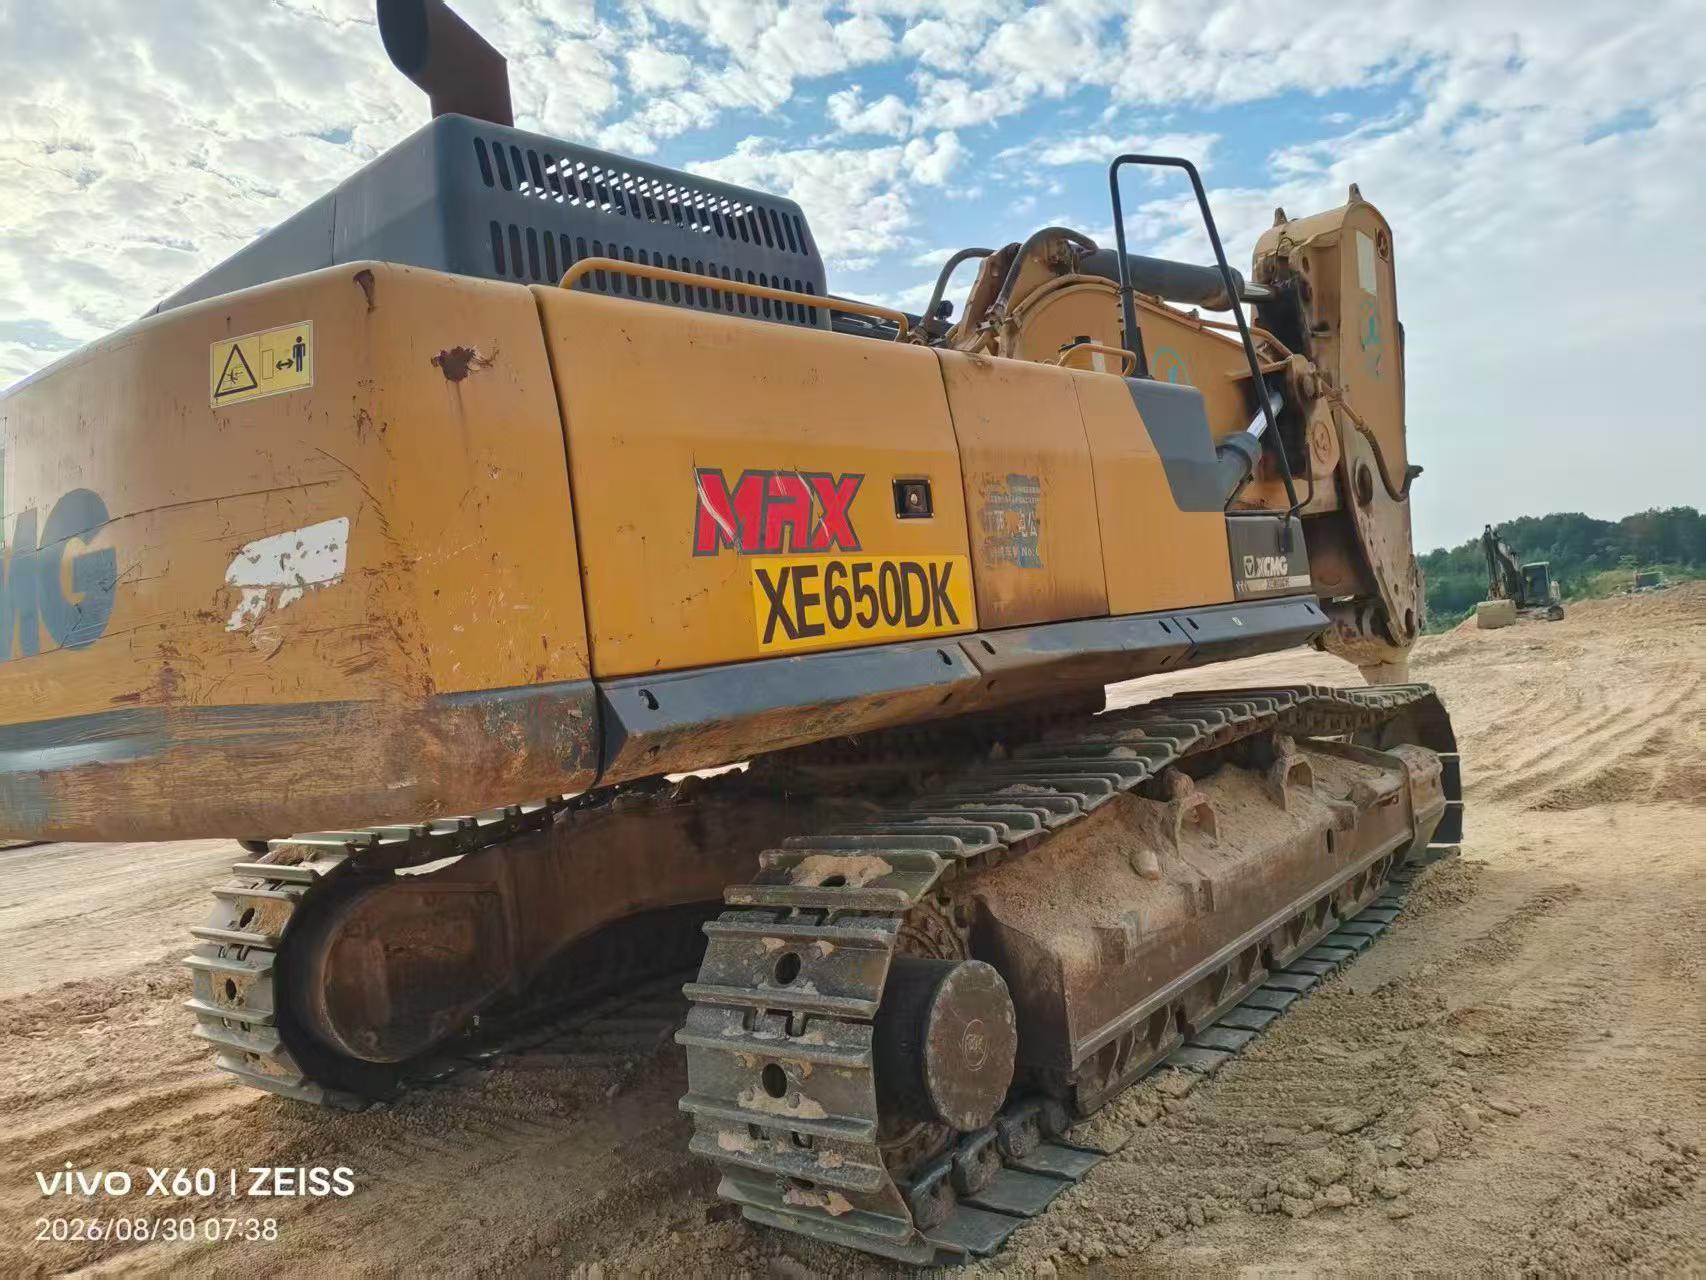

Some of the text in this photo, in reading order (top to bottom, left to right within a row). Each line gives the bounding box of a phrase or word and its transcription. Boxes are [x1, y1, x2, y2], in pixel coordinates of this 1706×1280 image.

[693, 468, 865, 557] MAX
[755, 560, 960, 644] XE650DK
[1256, 555, 1288, 577] XCMG
